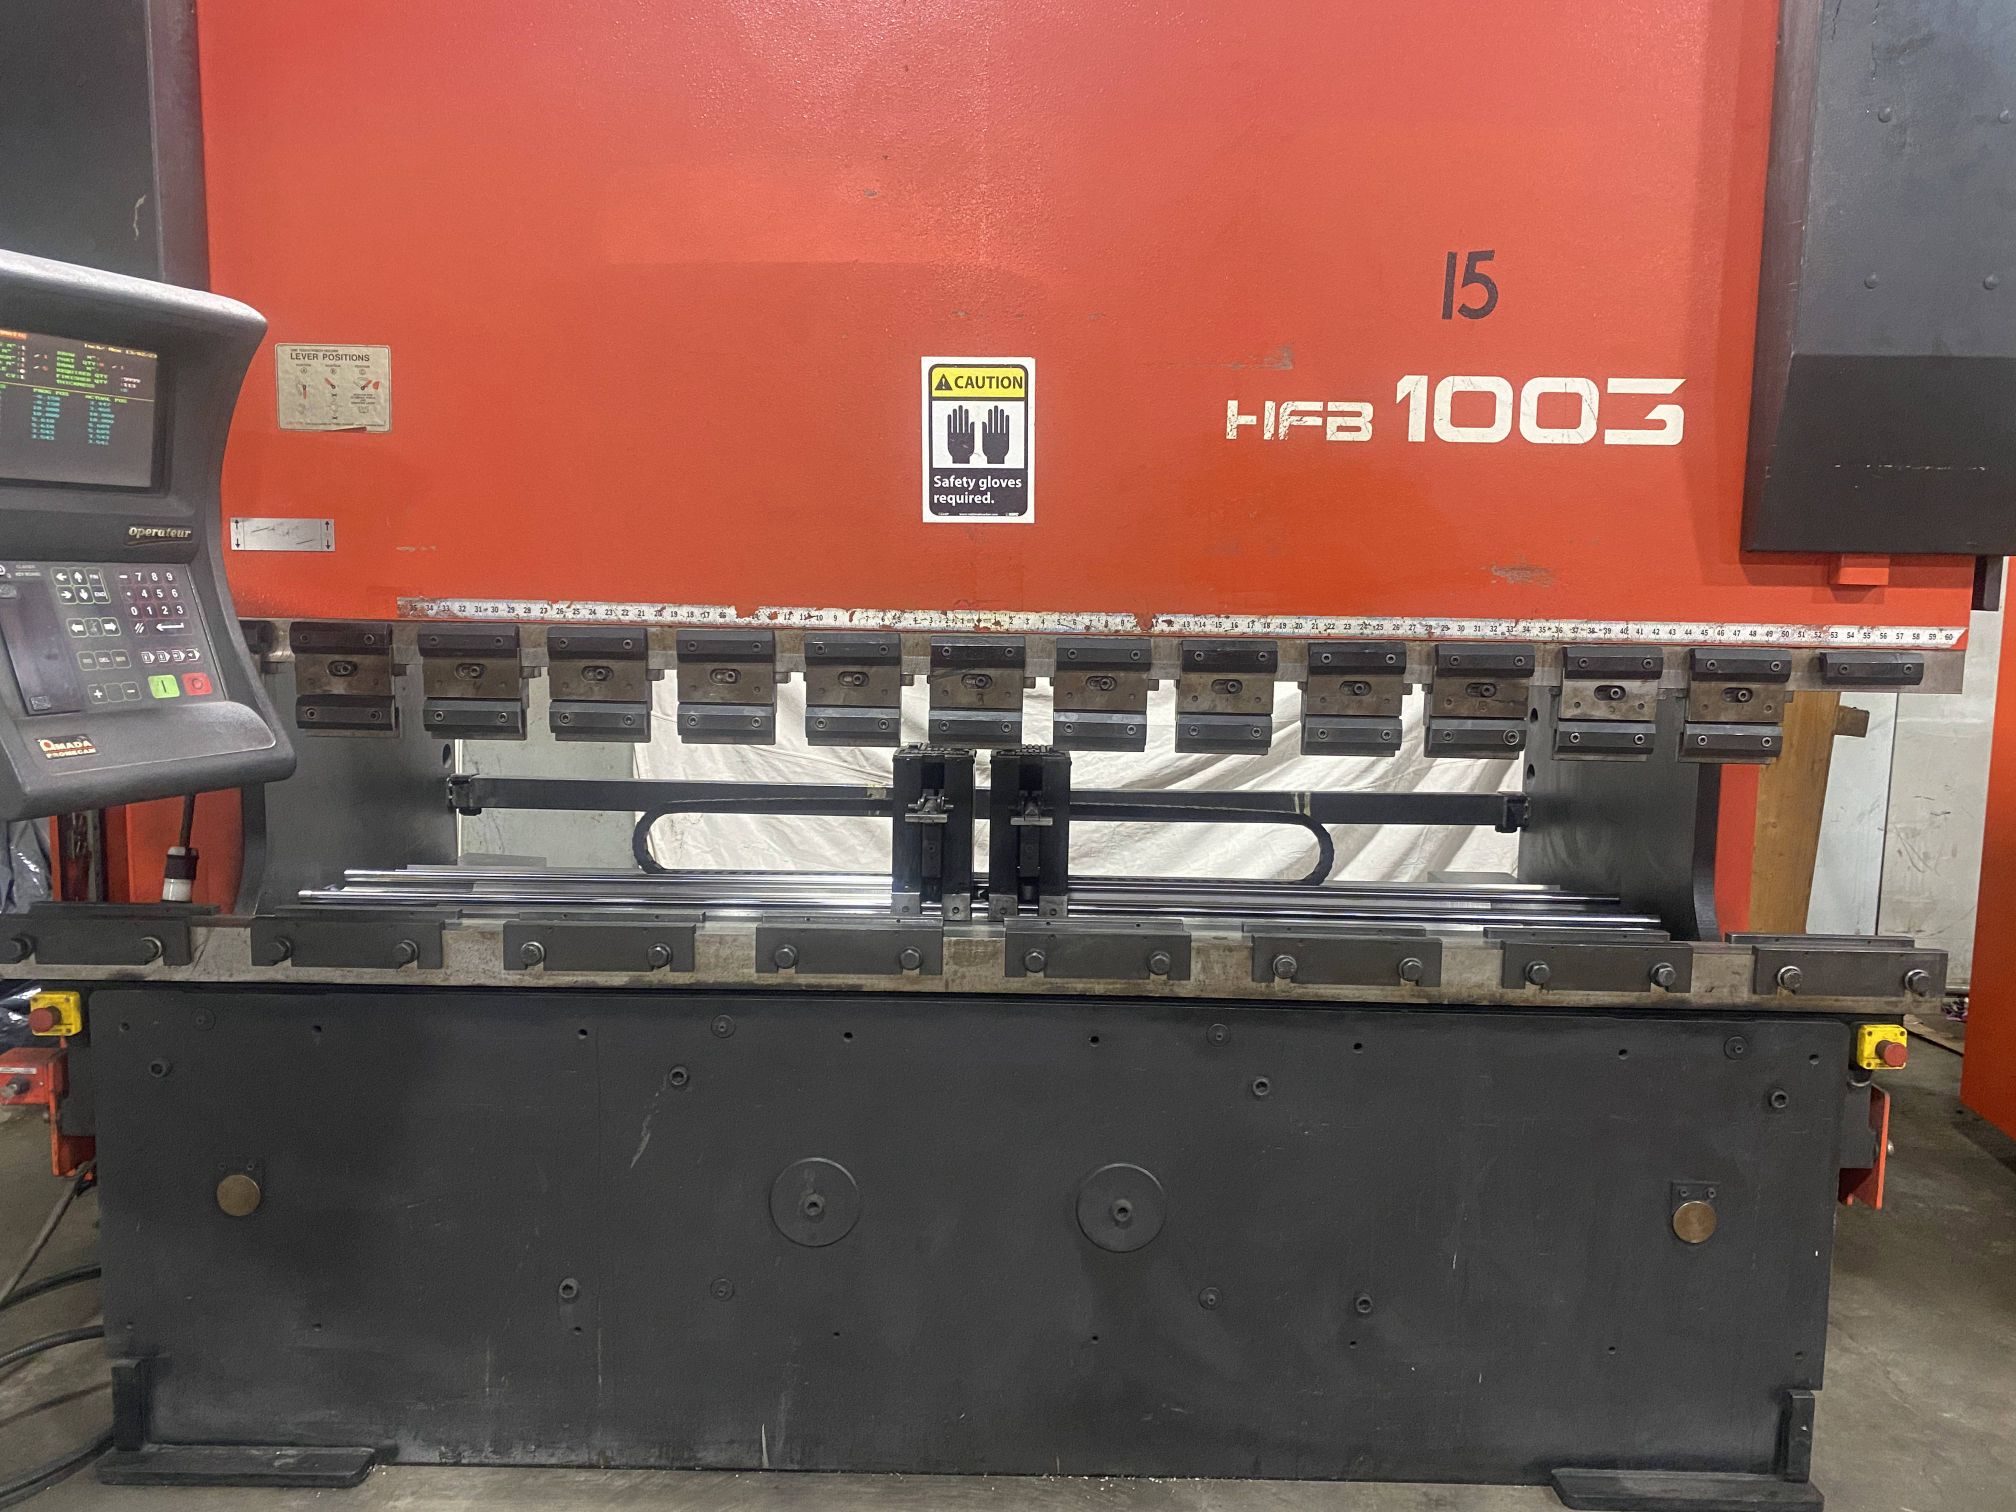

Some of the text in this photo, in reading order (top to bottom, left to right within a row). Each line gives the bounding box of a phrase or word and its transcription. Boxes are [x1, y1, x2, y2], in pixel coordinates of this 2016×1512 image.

[1441, 249, 1499, 320] 15
[290, 352, 370, 362] LEVER POSITIONS
[954, 375, 1023, 390] CAUTION
[1225, 374, 1687, 446] HFB 1003
[934, 475, 1022, 490] Safety gloves
[934, 492, 995, 506] required.
[135, 572, 173, 581] 7 8 9
[141, 589, 178, 598] 4 5 6
[147, 606, 153, 615] 1
[162, 606, 169, 615] 2
[177, 606, 183, 614] 3
